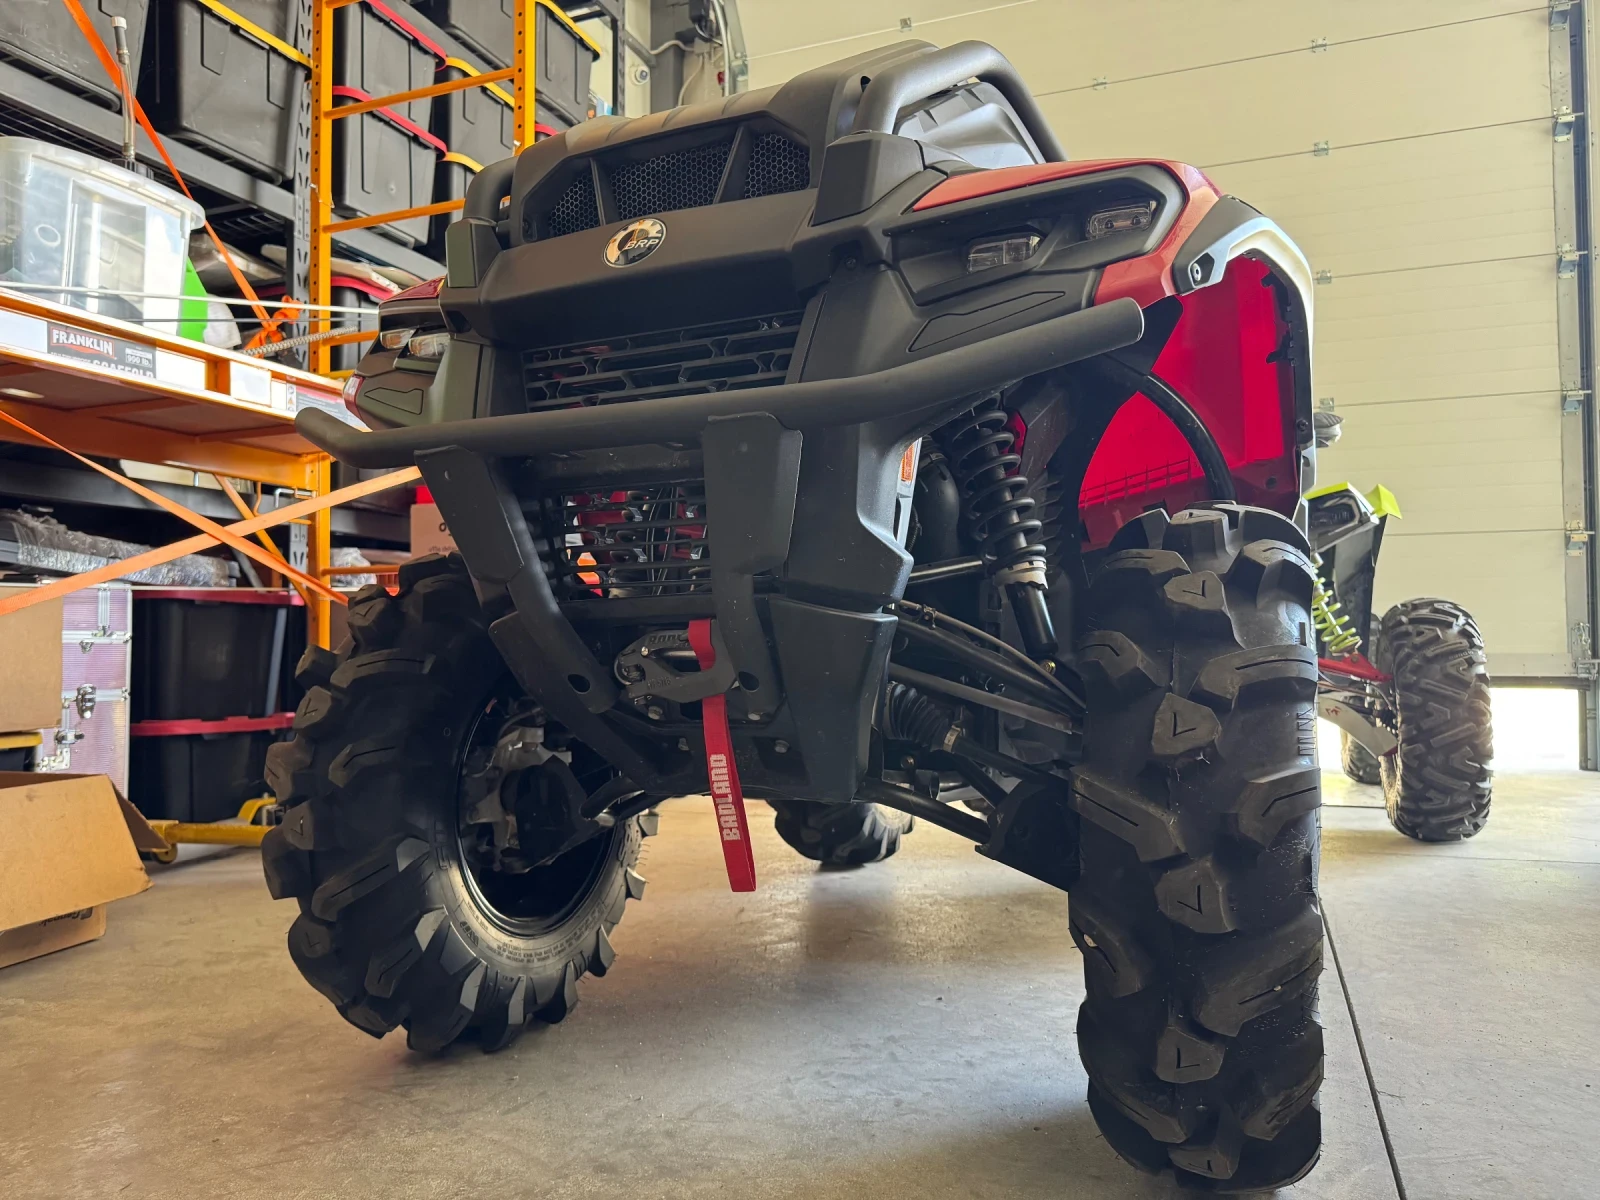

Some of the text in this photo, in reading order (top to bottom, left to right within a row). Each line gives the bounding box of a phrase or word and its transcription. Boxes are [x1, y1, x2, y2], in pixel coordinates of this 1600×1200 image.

[625, 238, 659, 249] BRP
[52, 329, 113, 355] FRANKLIN
[710, 754, 740, 840] BADLAND
